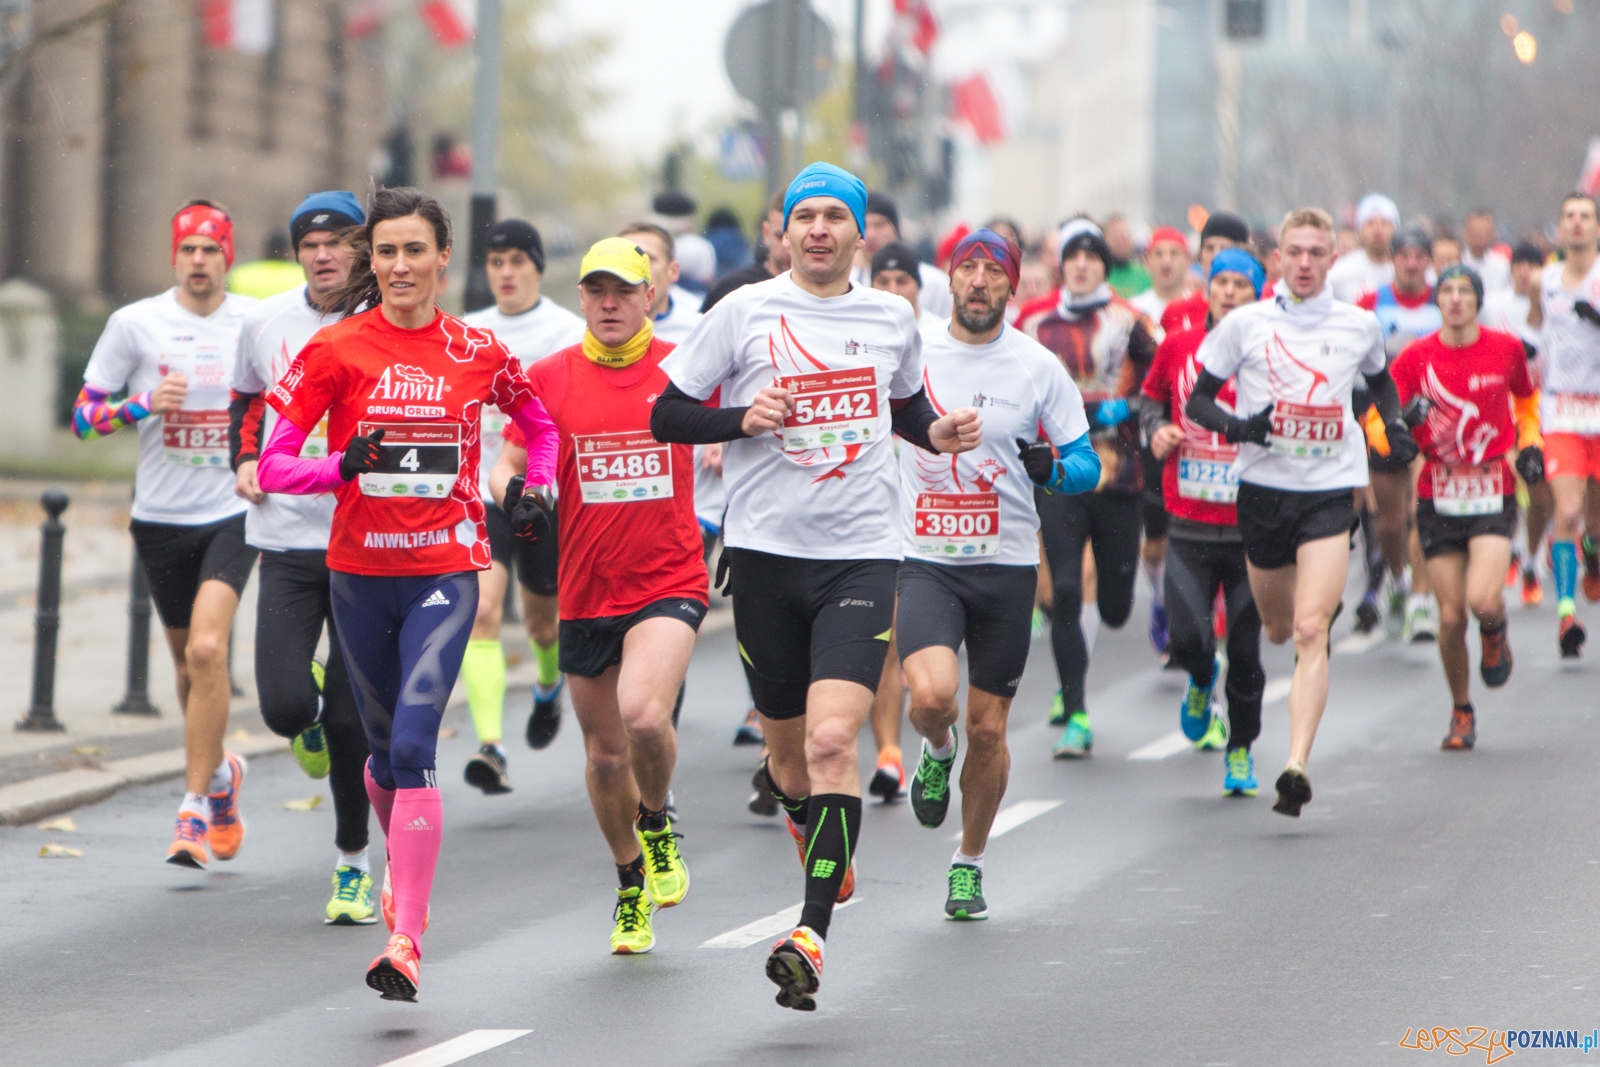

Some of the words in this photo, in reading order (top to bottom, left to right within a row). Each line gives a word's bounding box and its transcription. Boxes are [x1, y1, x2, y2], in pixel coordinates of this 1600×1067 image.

[368, 366, 445, 401] Anwil
[367, 405, 403, 415] GRUPA
[406, 406, 444, 417] ORLEN
[796, 393, 872, 423] 5442
[400, 448, 420, 471] 4
[592, 453, 661, 479] 5486
[926, 514, 991, 535] 3900
[363, 529, 450, 548] ANWILTEAM
[422, 599, 450, 607] adidas
